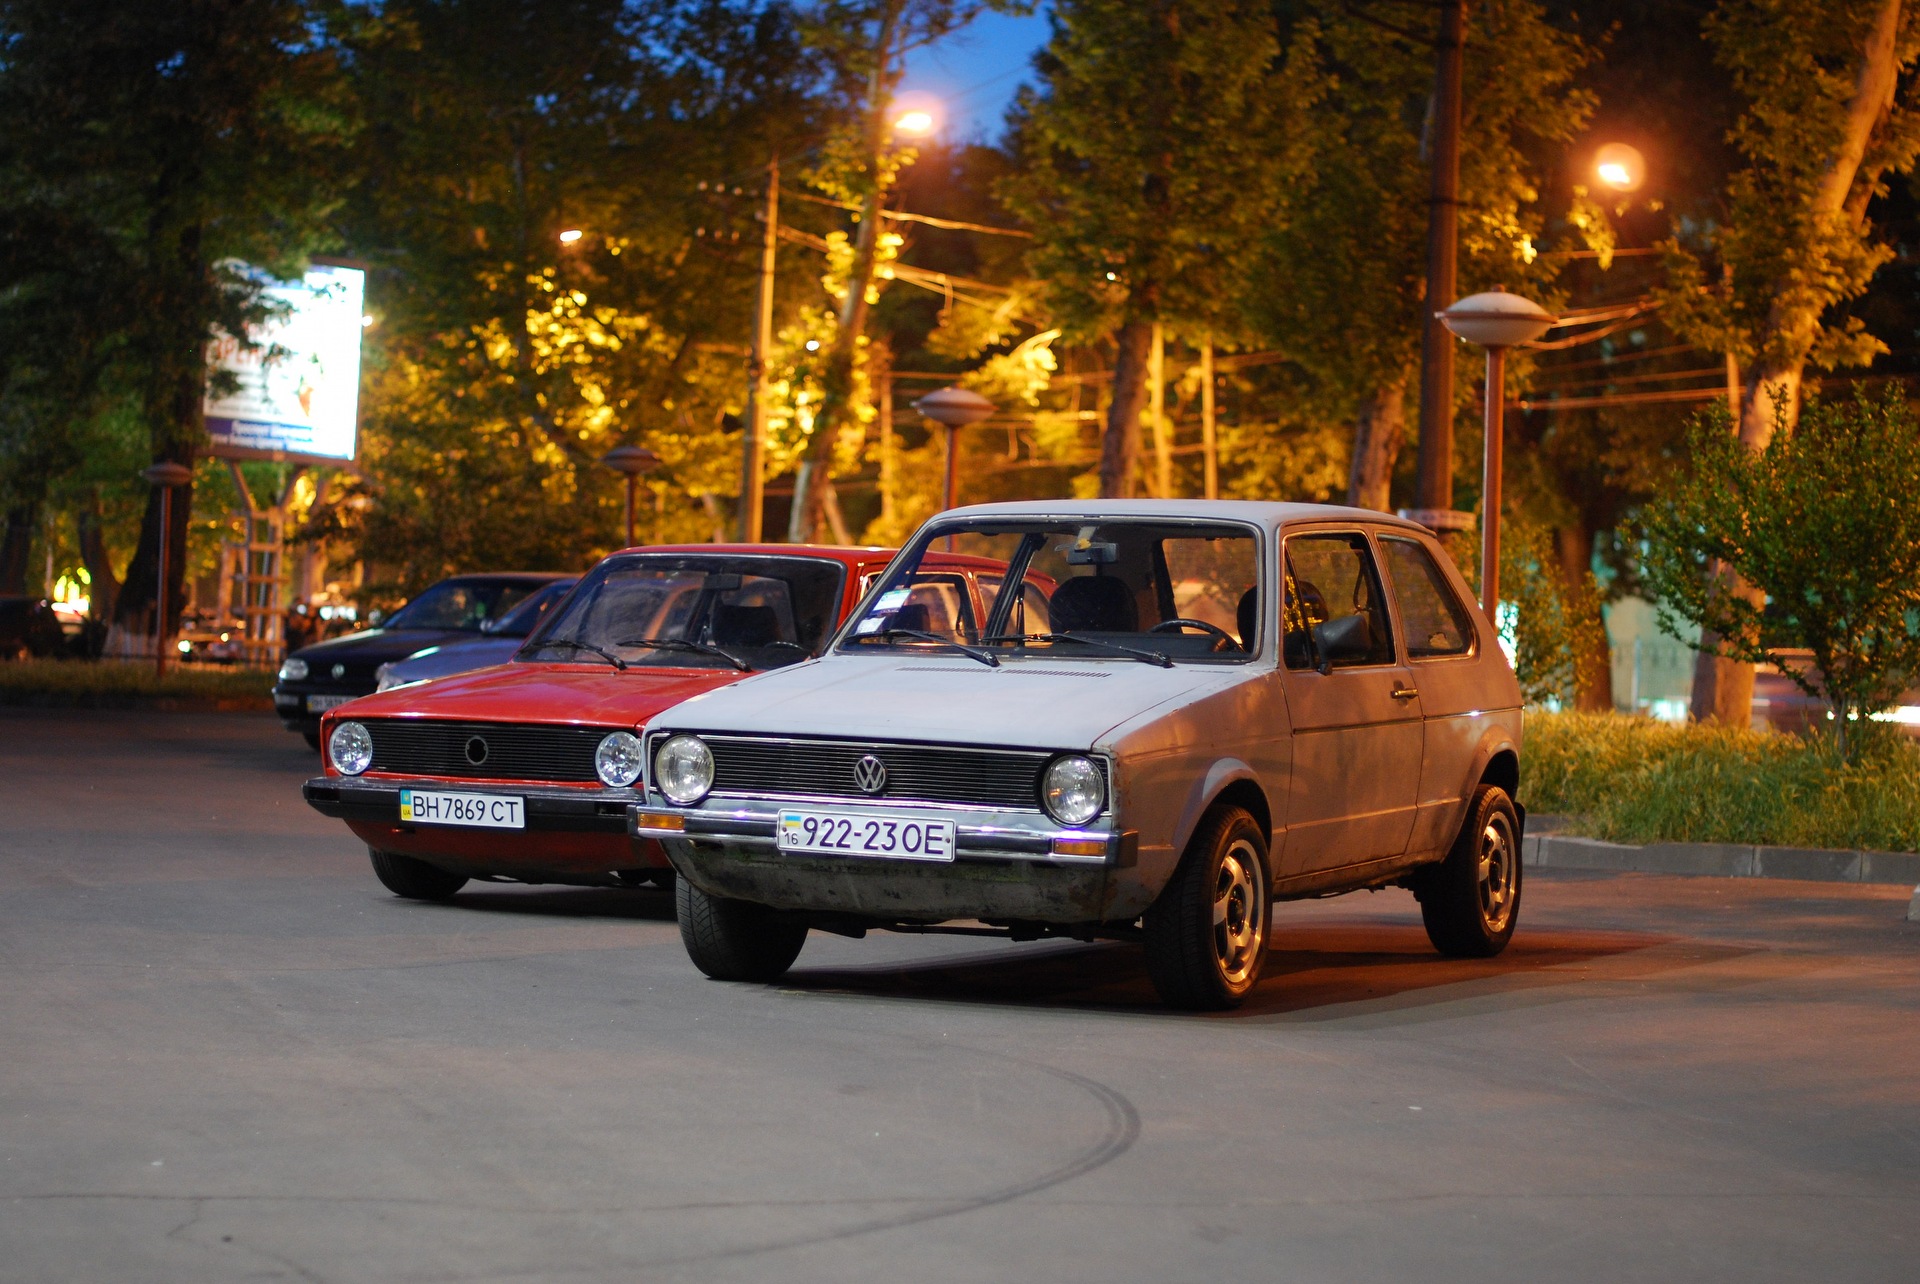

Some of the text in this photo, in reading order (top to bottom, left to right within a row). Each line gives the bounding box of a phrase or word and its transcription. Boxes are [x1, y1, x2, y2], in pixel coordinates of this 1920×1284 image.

[413, 796, 519, 823] BH 7869 CT
[784, 833, 799, 845] 16
